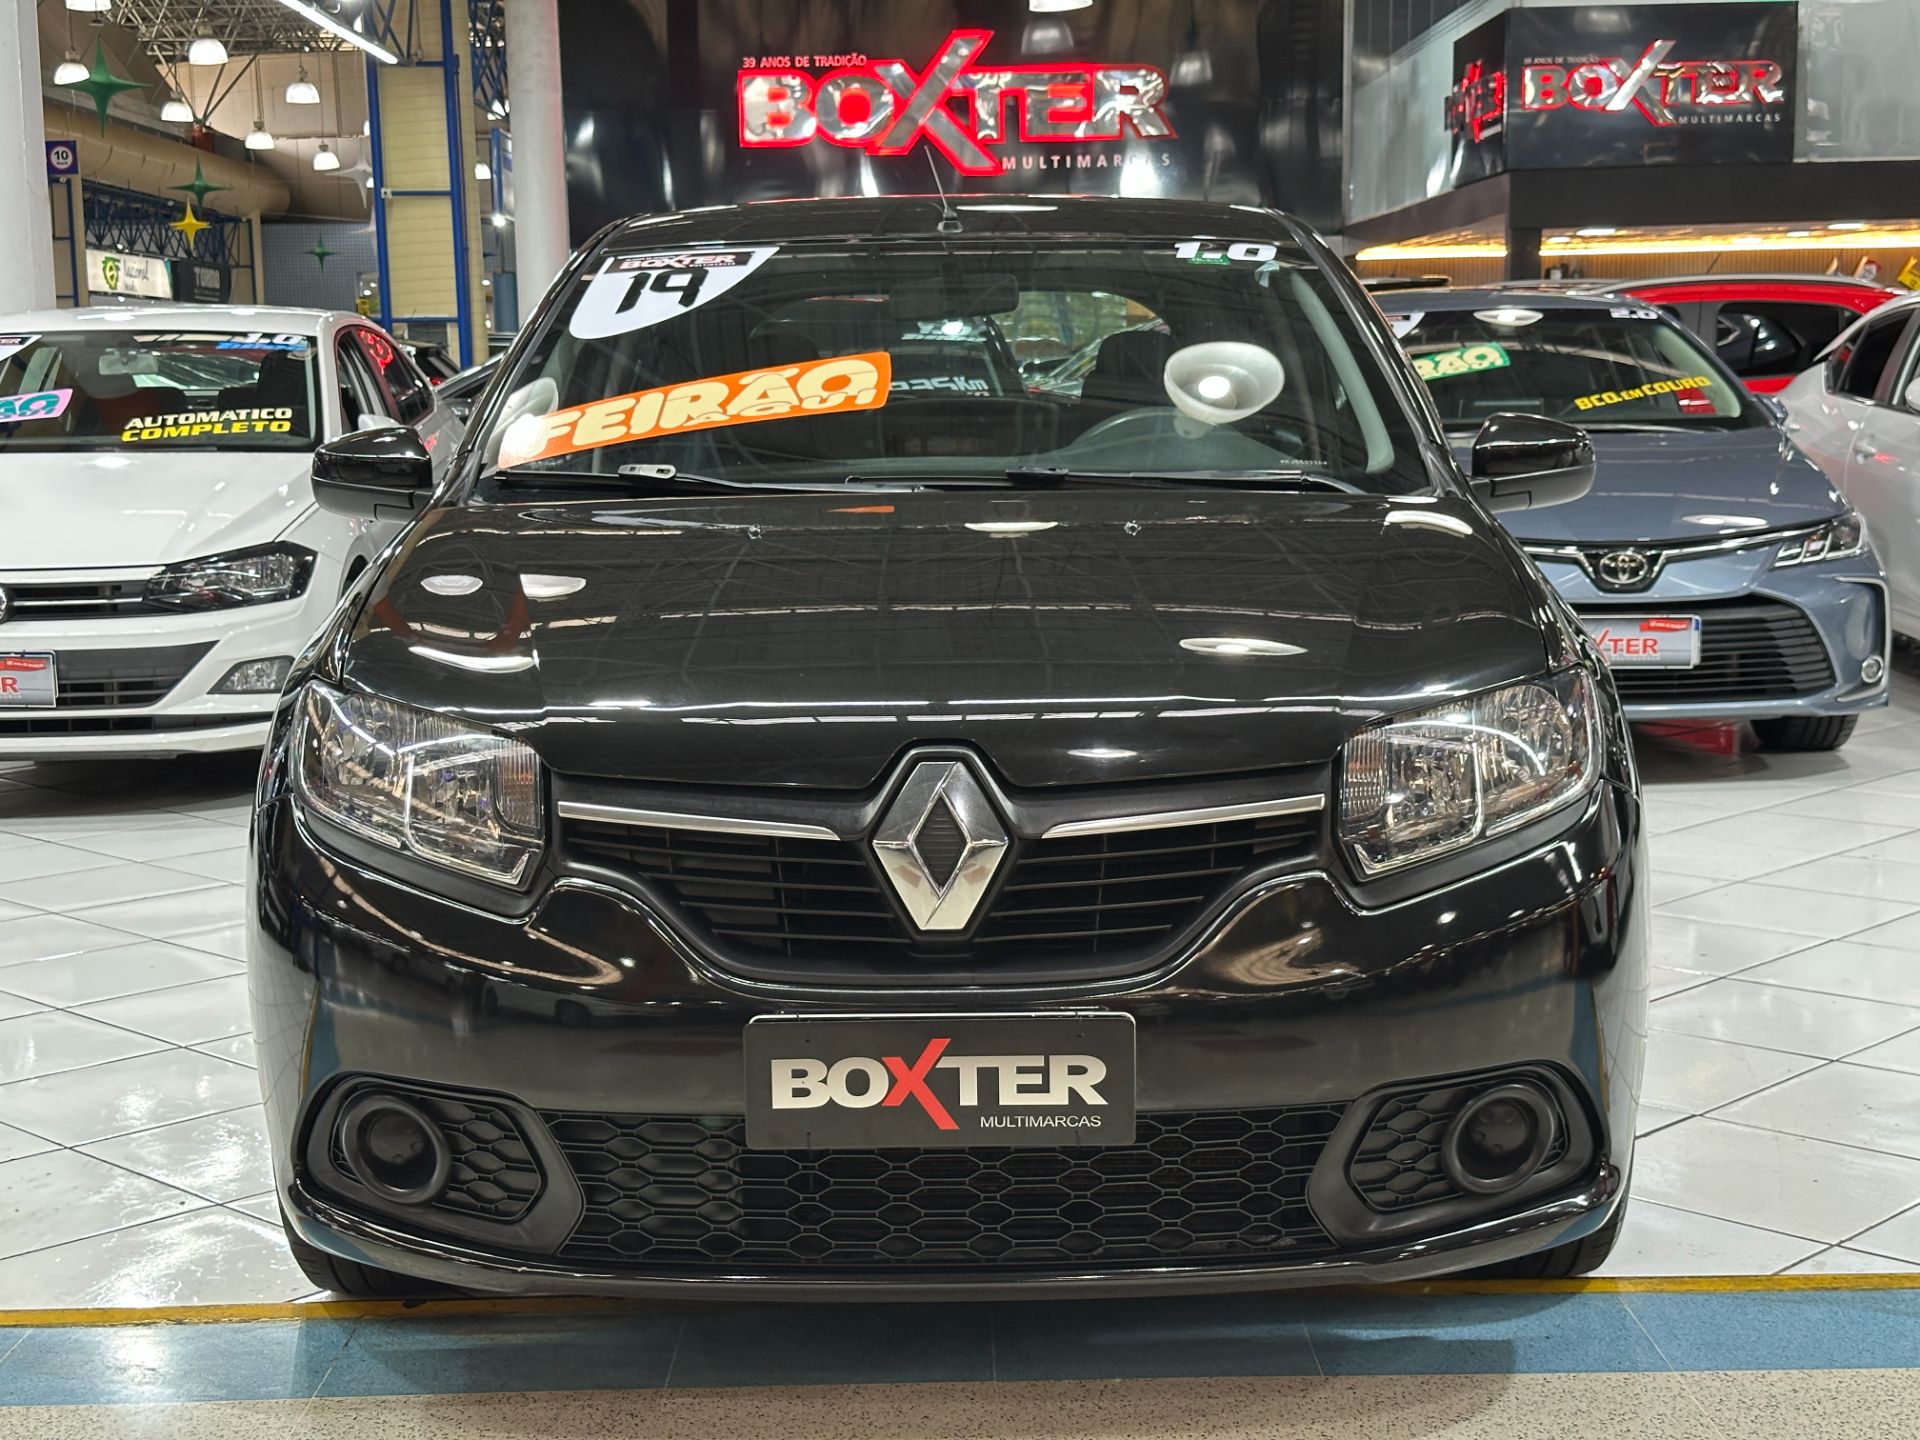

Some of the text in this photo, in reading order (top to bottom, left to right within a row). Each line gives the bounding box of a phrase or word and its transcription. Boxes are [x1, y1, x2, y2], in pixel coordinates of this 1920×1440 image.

[742, 53, 867, 68] 39 ANOS DE TRADIÇÃO
[1521, 38, 1785, 127] BOXTER
[737, 28, 1178, 177] BOXTER
[1678, 113, 1782, 125] MULTIMARCAS
[54, 150, 69, 161] 10
[619, 254, 737, 270] BOXTER
[1174, 241, 1278, 262] 1.0
[615, 268, 710, 315] 19
[124, 407, 293, 430] AUTOMATICO
[518, 359, 879, 458] FEIRÃO
[121, 420, 291, 442] COMPLETO
[771, 1037, 1109, 1130] BOXTER
[980, 1114, 1102, 1129] MULTIMARCAS
